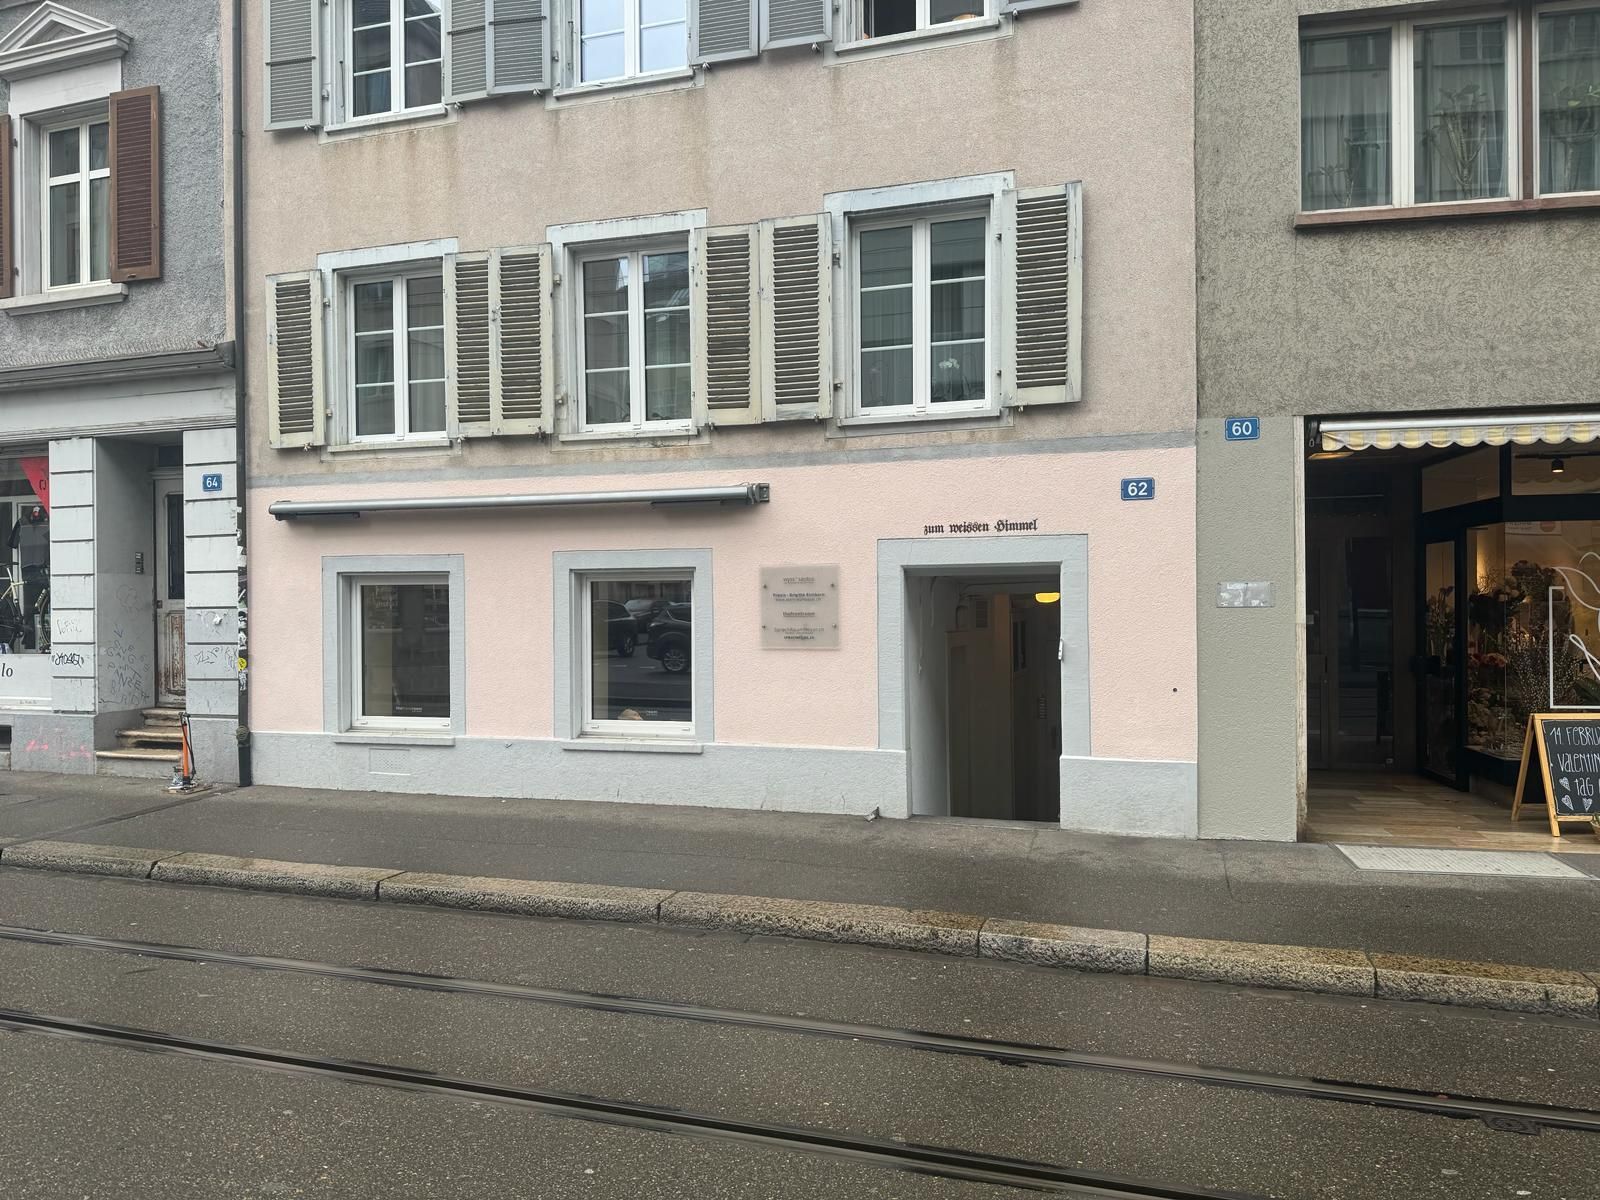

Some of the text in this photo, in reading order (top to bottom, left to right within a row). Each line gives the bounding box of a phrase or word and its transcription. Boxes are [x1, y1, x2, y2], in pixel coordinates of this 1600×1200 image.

[1231, 421, 1252, 436] 60
[206, 477, 218, 488] 64
[1127, 482, 1148, 496] 62
[923, 524, 944, 535] zum
[949, 521, 989, 533] weissen
[1, 662, 14, 678] lo
